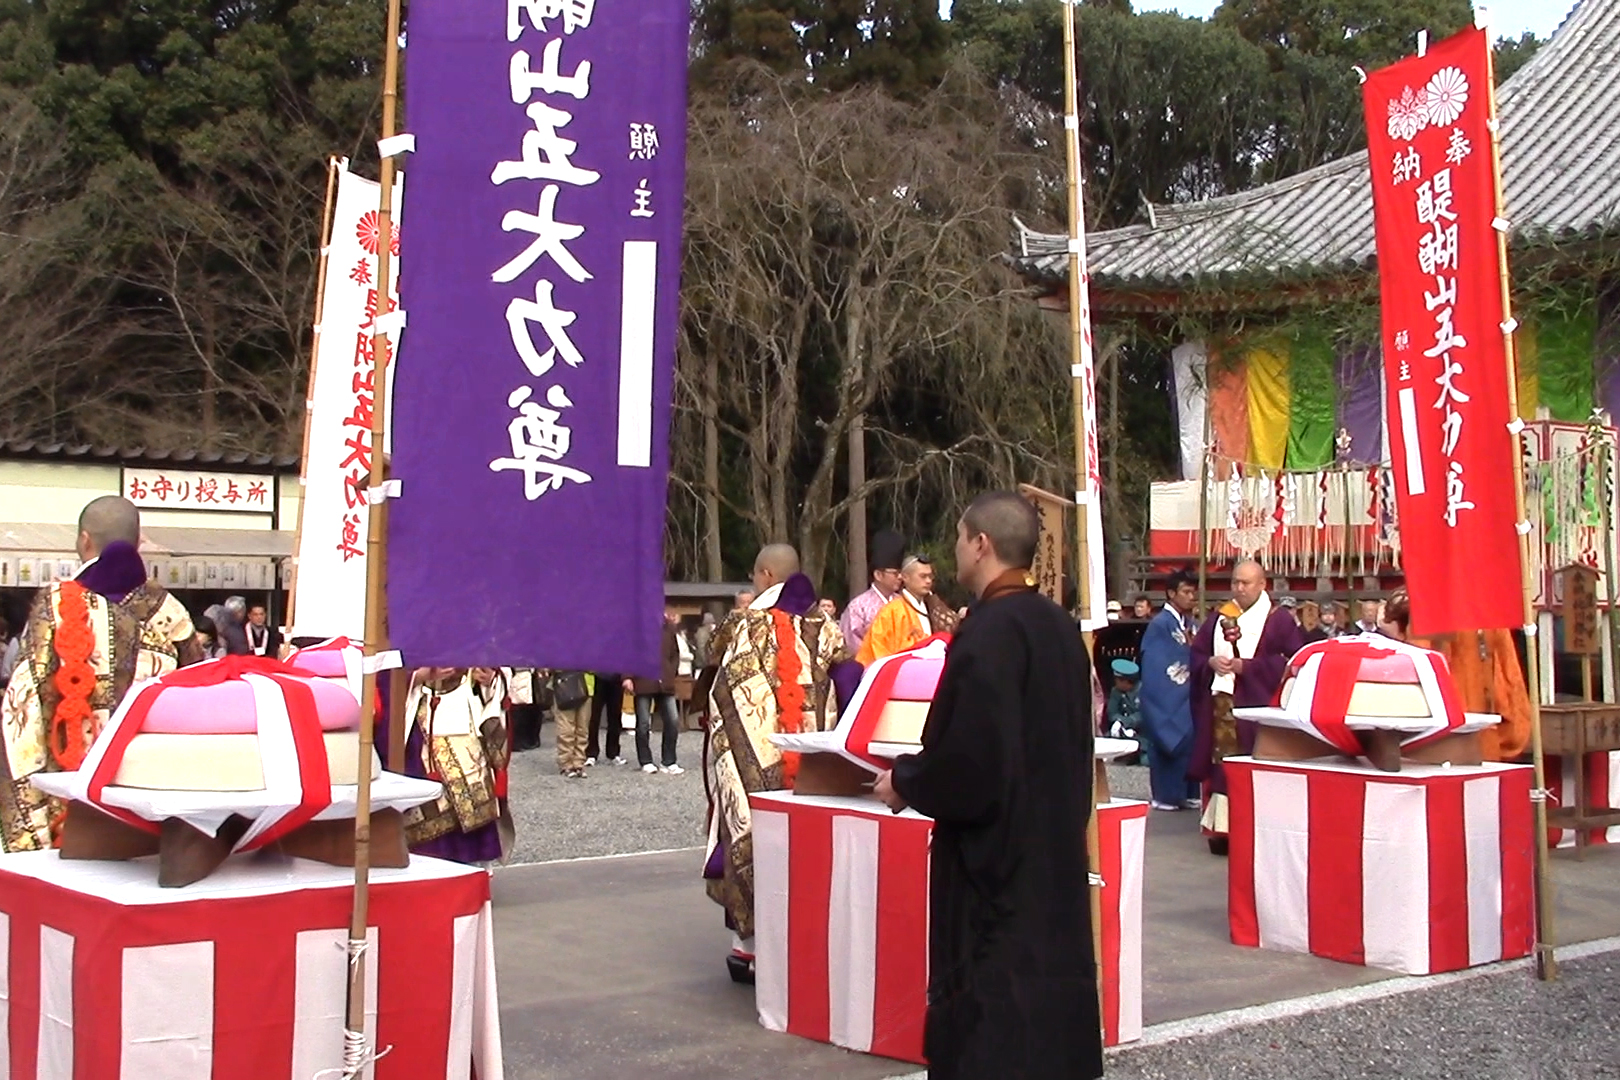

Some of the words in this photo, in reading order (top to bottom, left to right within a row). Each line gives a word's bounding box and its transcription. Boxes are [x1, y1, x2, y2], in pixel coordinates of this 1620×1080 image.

[1416, 168, 1475, 527] 醍醐山五大力尊
[129, 475, 268, 505] お守り授与所
